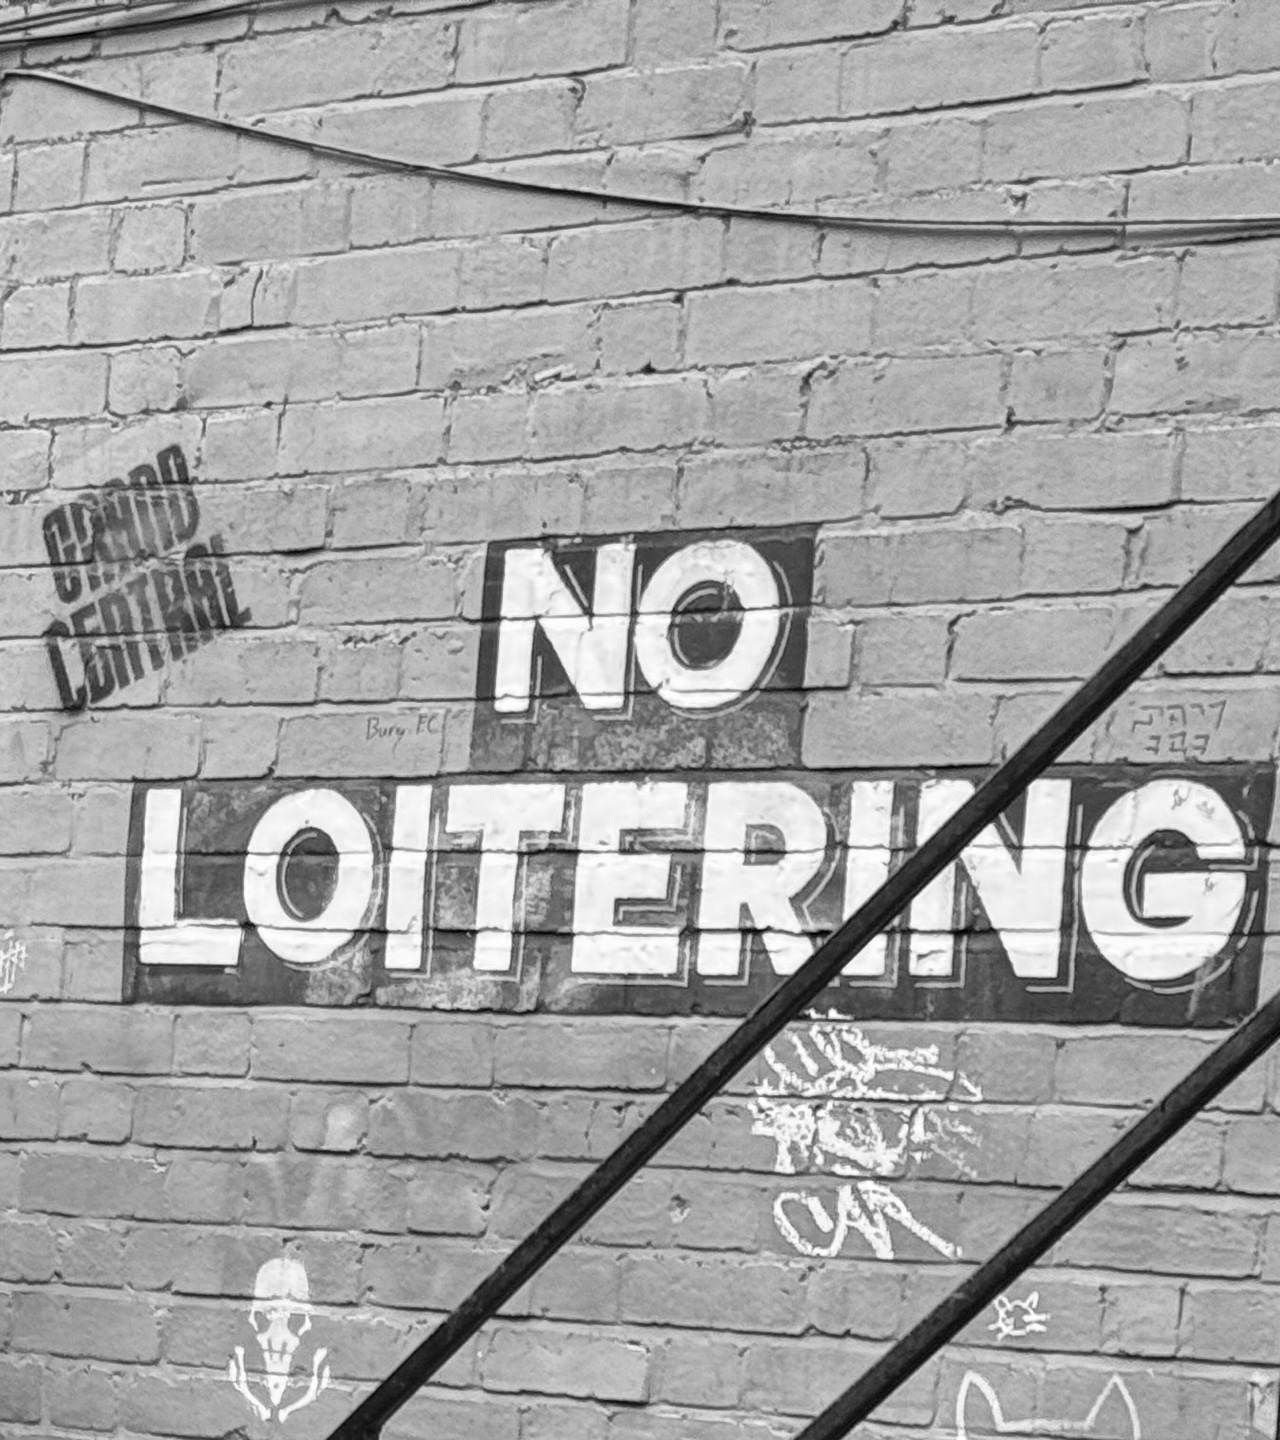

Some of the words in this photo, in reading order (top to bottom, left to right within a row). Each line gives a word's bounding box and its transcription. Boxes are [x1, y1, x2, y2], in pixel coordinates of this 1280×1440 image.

[42, 443, 201, 605] GRAND
[42, 533, 253, 712] CENTRAL
[493, 538, 782, 714] NO
[365, 716, 407, 753] Bury
[415, 712, 439, 736] FC
[138, 777, 1248, 982] LOITERING
